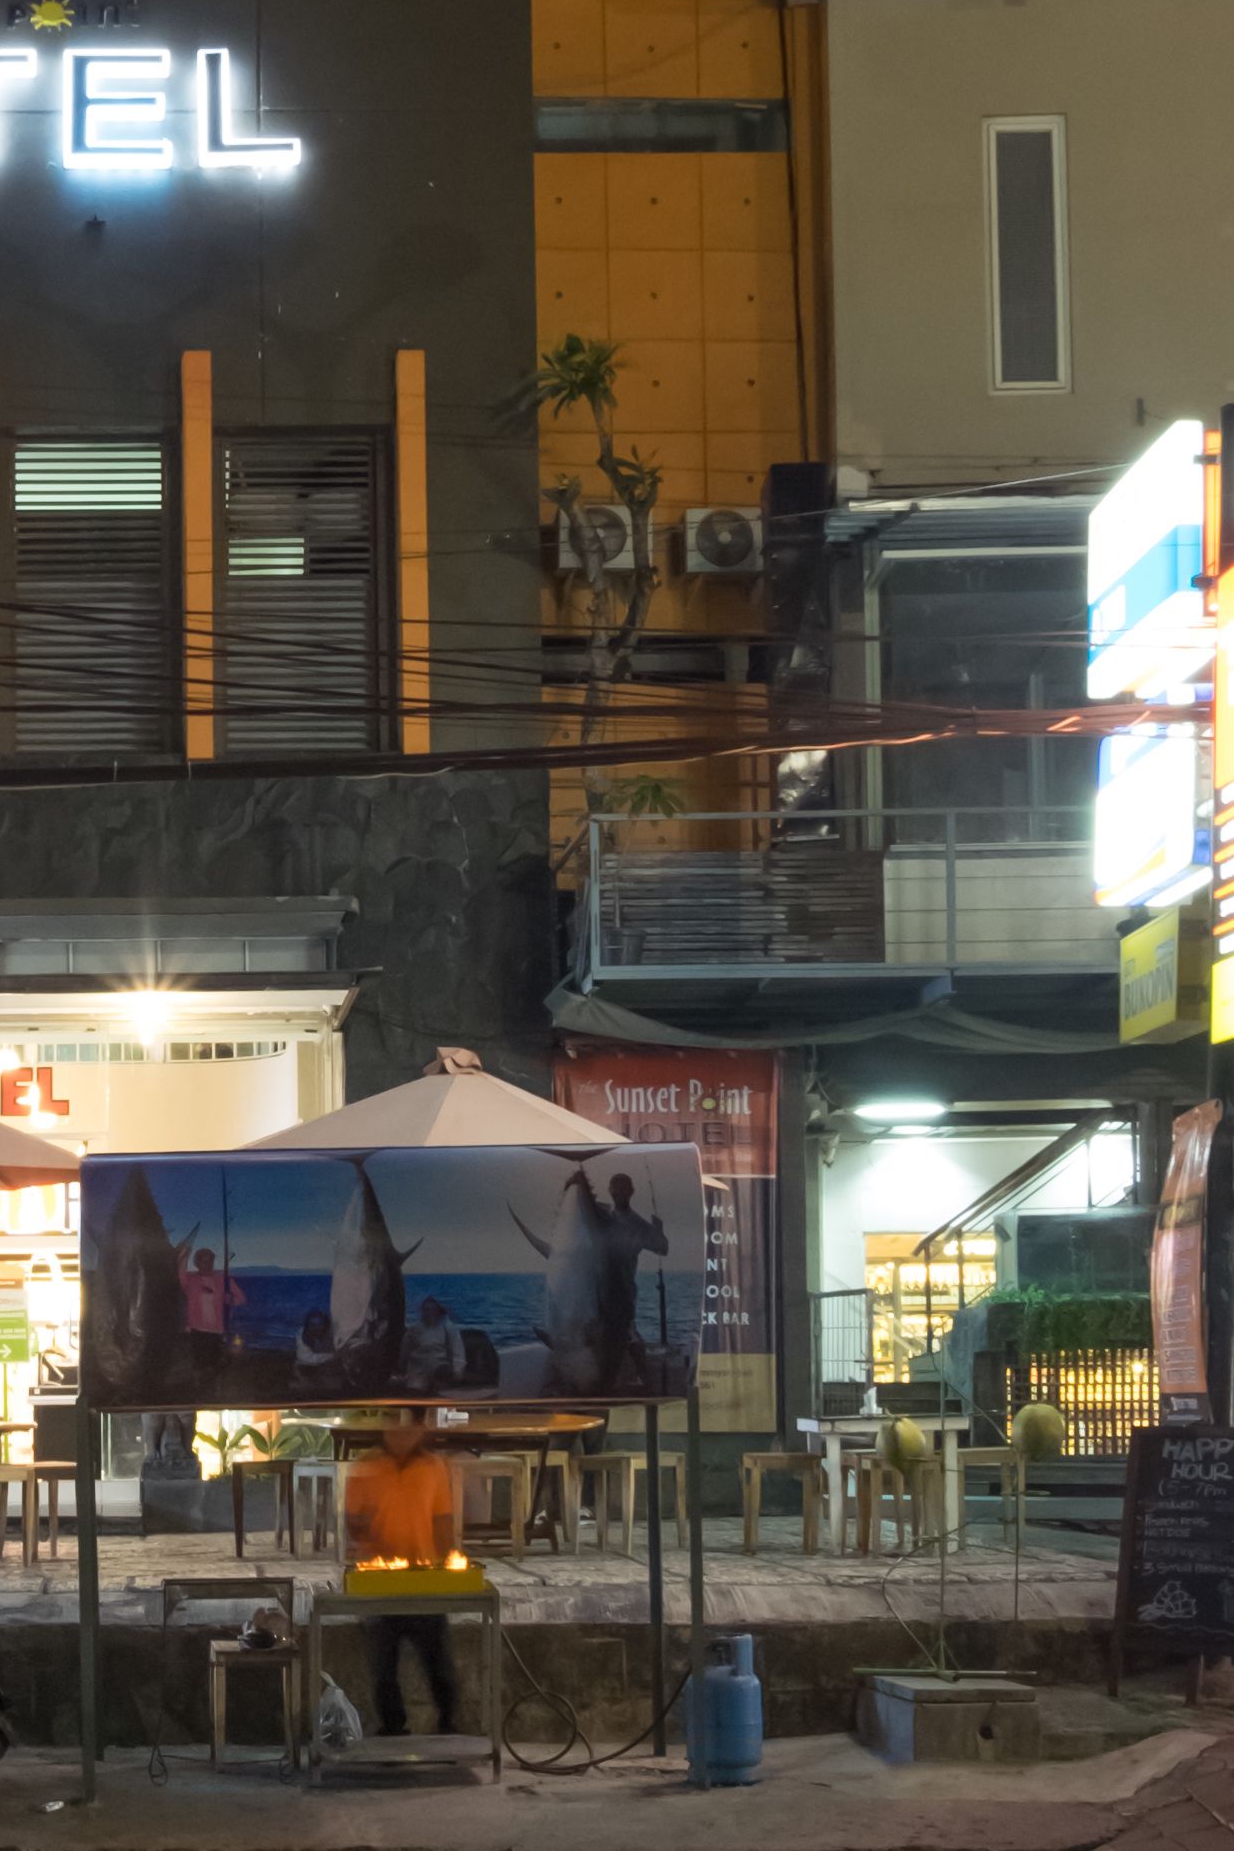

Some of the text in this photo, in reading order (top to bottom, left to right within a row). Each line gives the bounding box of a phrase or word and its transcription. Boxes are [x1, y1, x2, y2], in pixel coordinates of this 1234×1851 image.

[604, 1079, 682, 1115] Sunset
[705, 1284, 741, 1299] OOL
[722, 1311, 751, 1326] BAR
[1161, 1437, 1234, 1461] HAPP
[1170, 1461, 1234, 1482] HOUR
